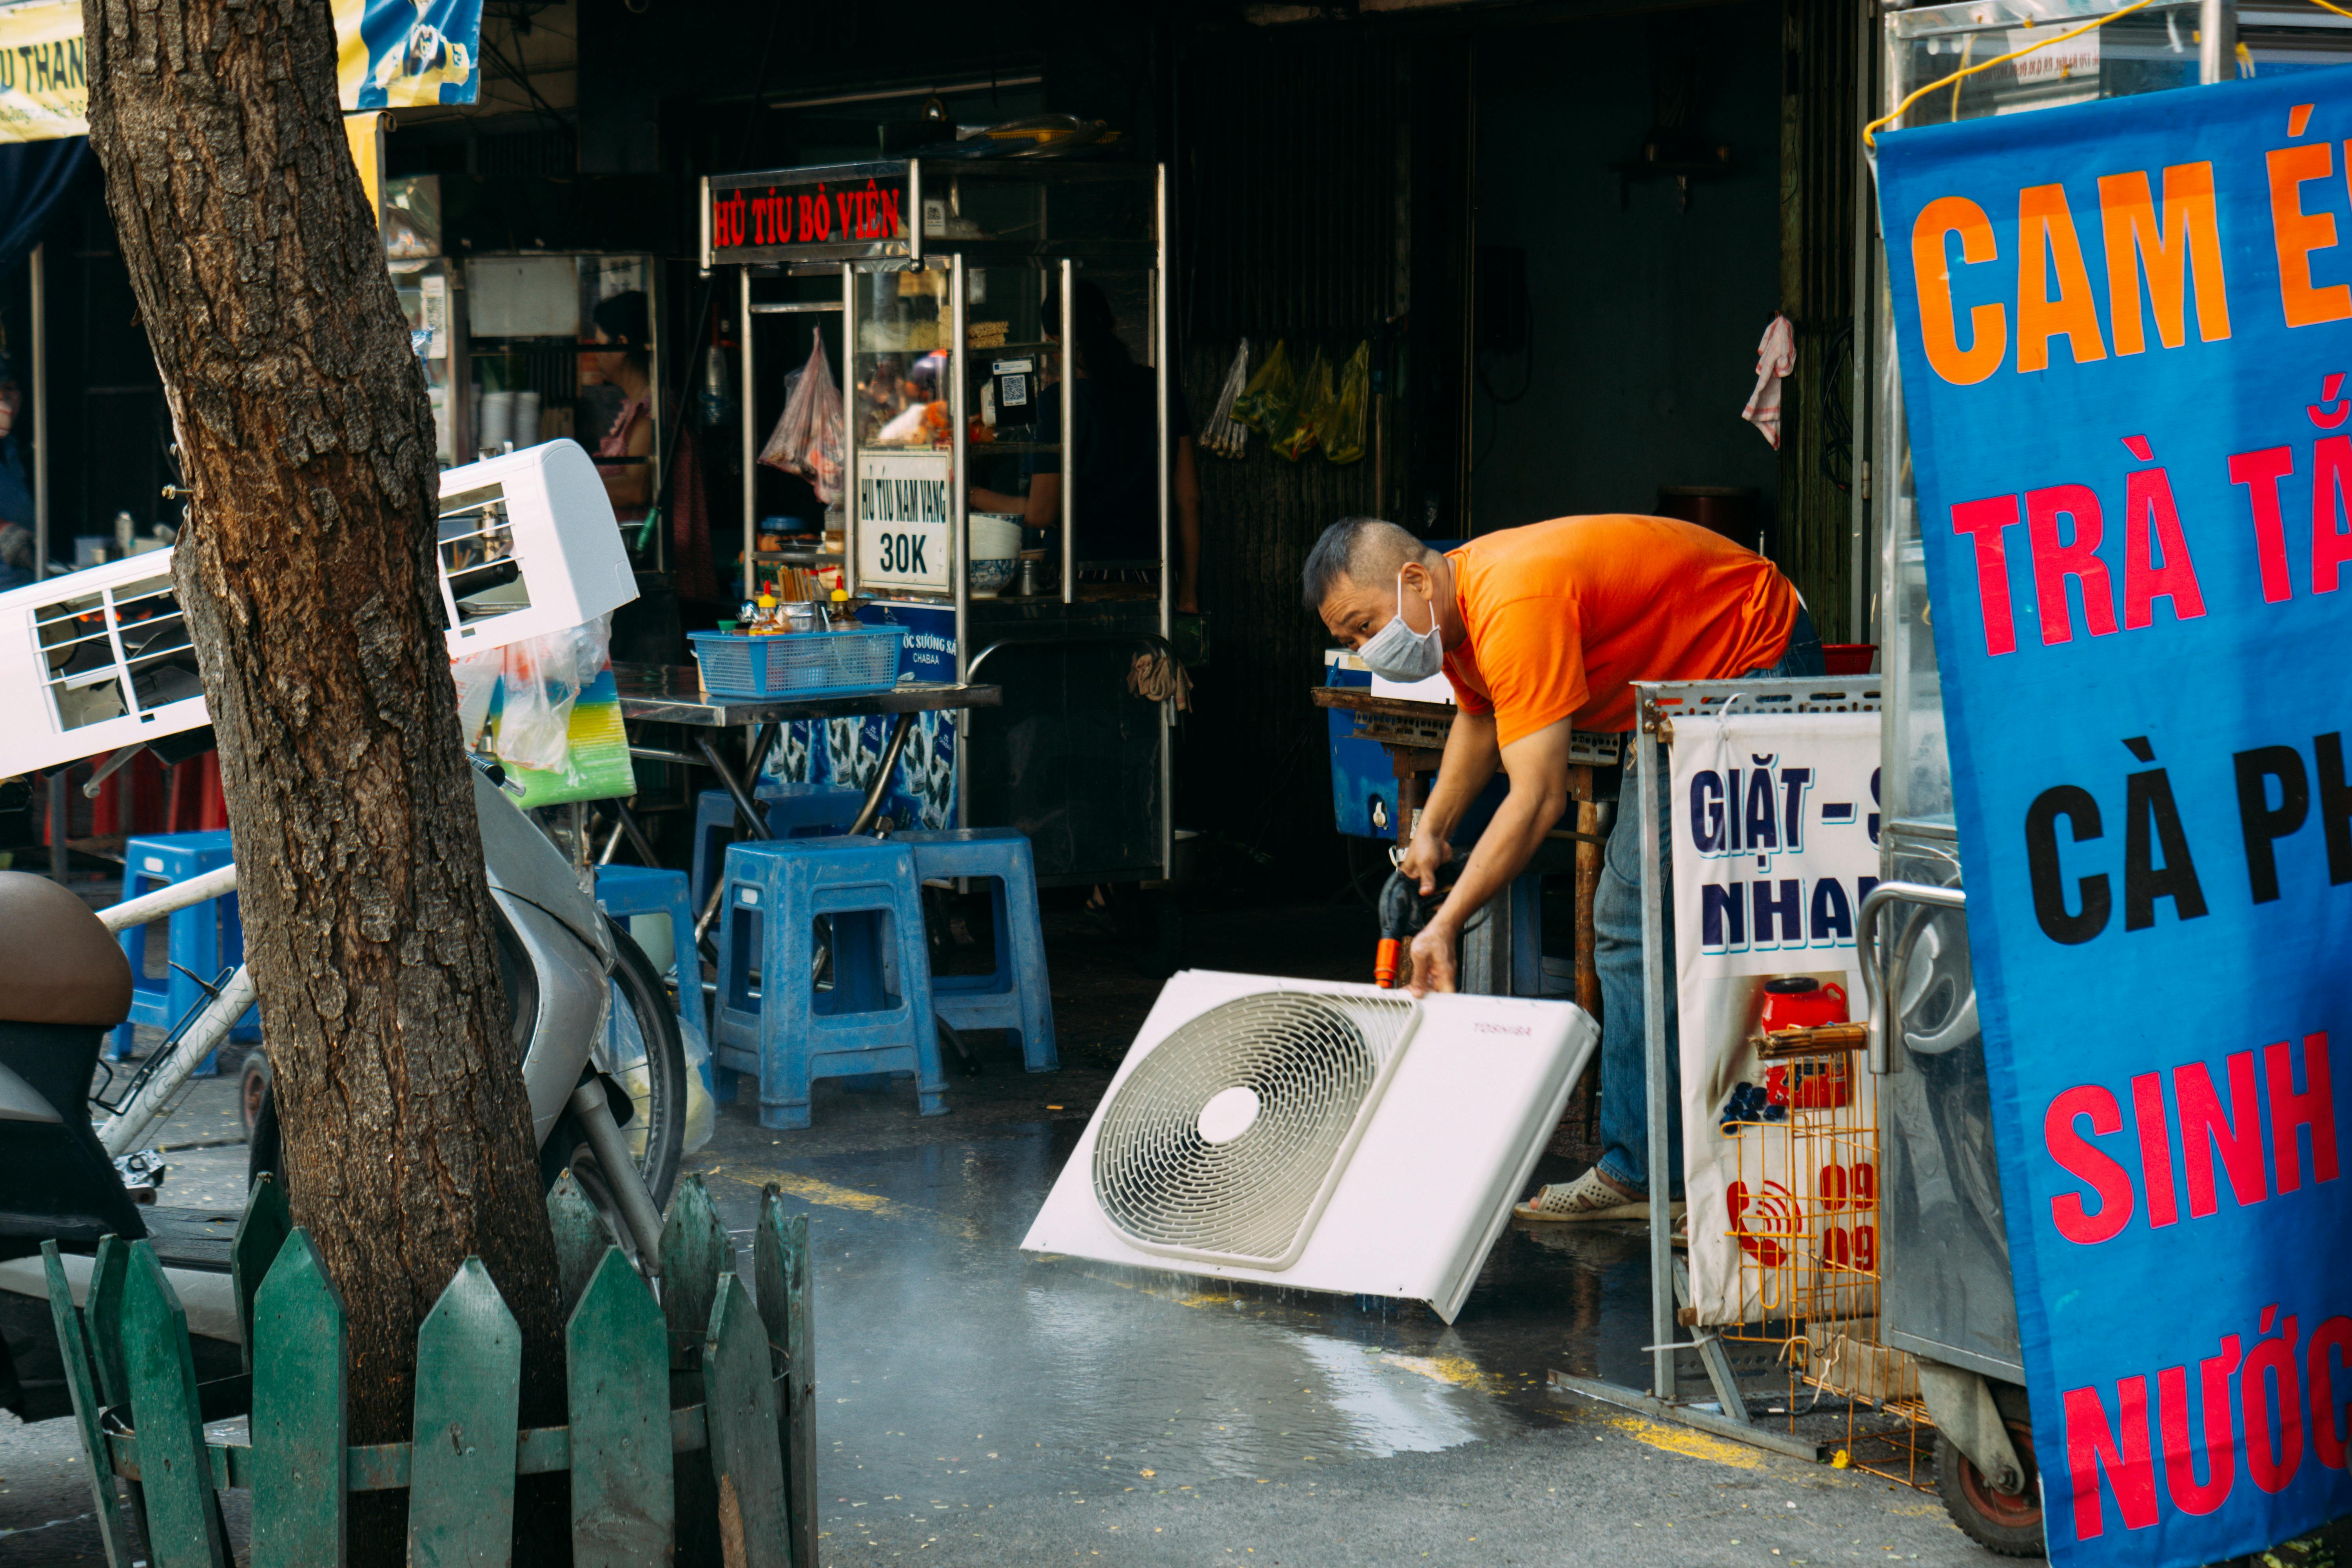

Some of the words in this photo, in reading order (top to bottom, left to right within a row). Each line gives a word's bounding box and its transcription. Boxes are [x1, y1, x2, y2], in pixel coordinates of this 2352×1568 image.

[715, 189, 746, 247] HỦ
[751, 186, 793, 245] TÍU
[798, 182, 831, 242] BÒ
[836, 177, 899, 240] VIÊN
[1911, 160, 2232, 386] CAM
[2265, 103, 2352, 328] É
[880, 532, 927, 574] 30K
[895, 479, 918, 523] NAM
[920, 480, 946, 524] VANG
[1950, 434, 2207, 657] TRÀ
[913, 652, 940, 665] CHABAA
[1690, 753, 1814, 873] GIẶT
[2024, 735, 2209, 946] CÀ
[2044, 1029, 2341, 1246] SINH
[2062, 1303, 2352, 1542] NƯỚC
